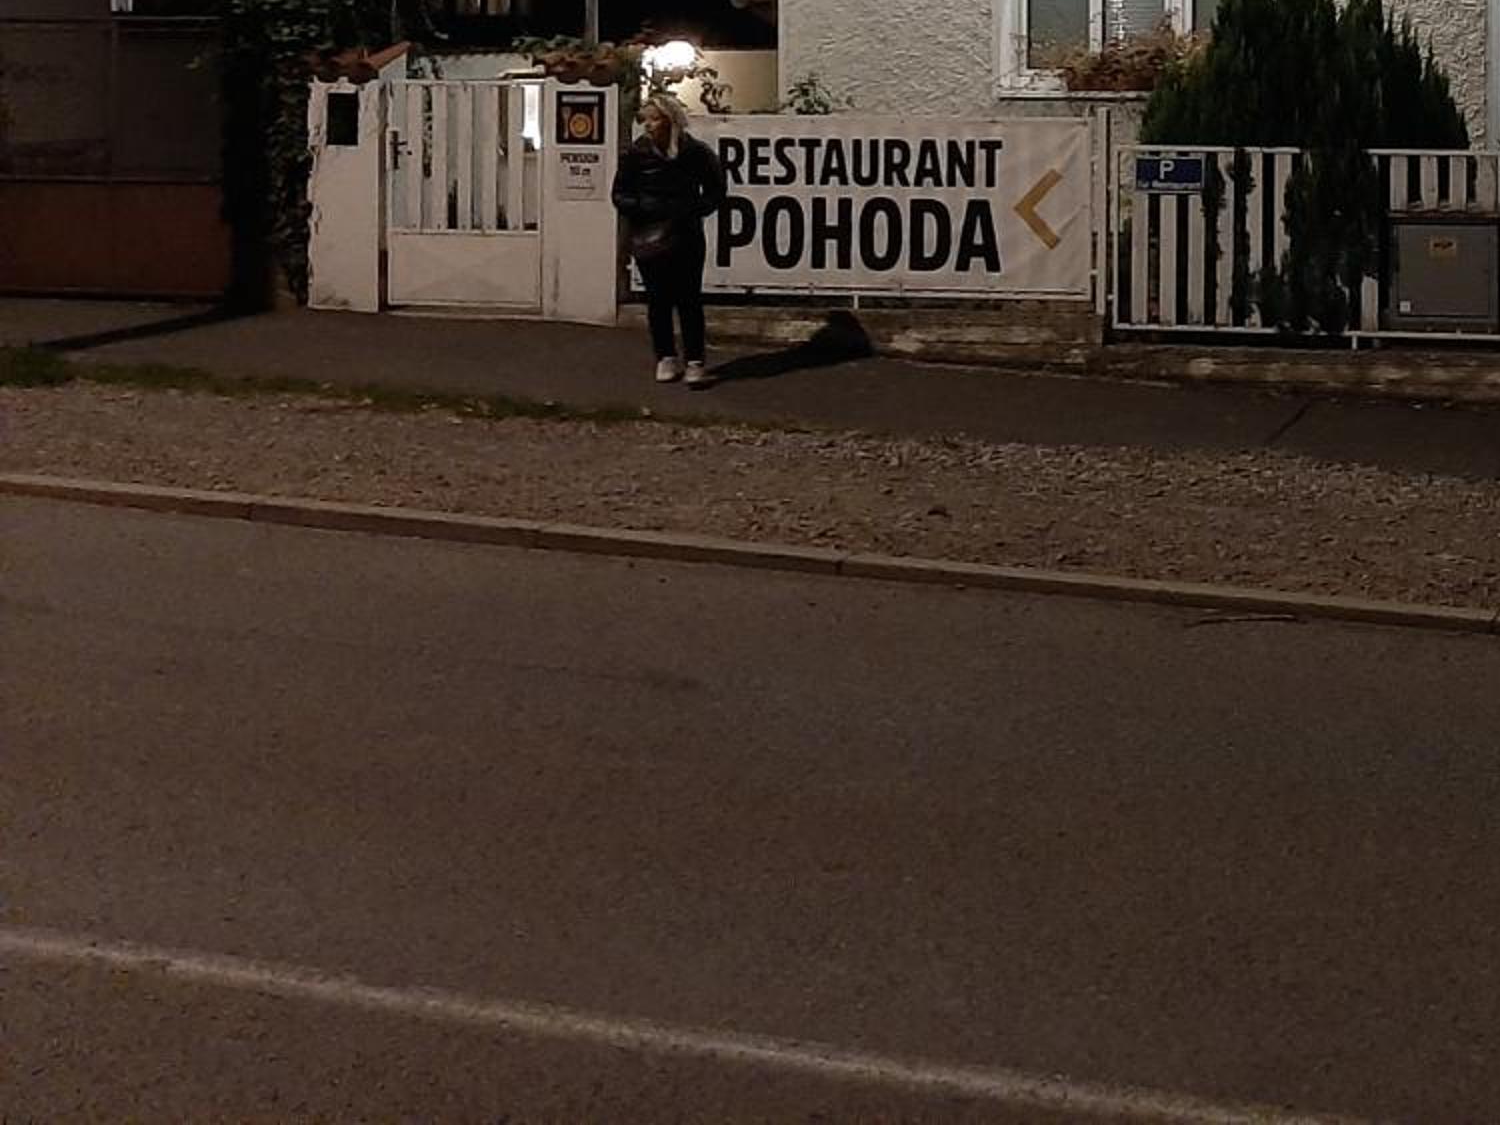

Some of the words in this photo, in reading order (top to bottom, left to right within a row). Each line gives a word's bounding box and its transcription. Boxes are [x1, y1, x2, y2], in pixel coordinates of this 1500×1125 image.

[718, 137, 1003, 187] RESTAURANT
[1159, 159, 1176, 180] P
[716, 195, 1001, 273] POHODA
